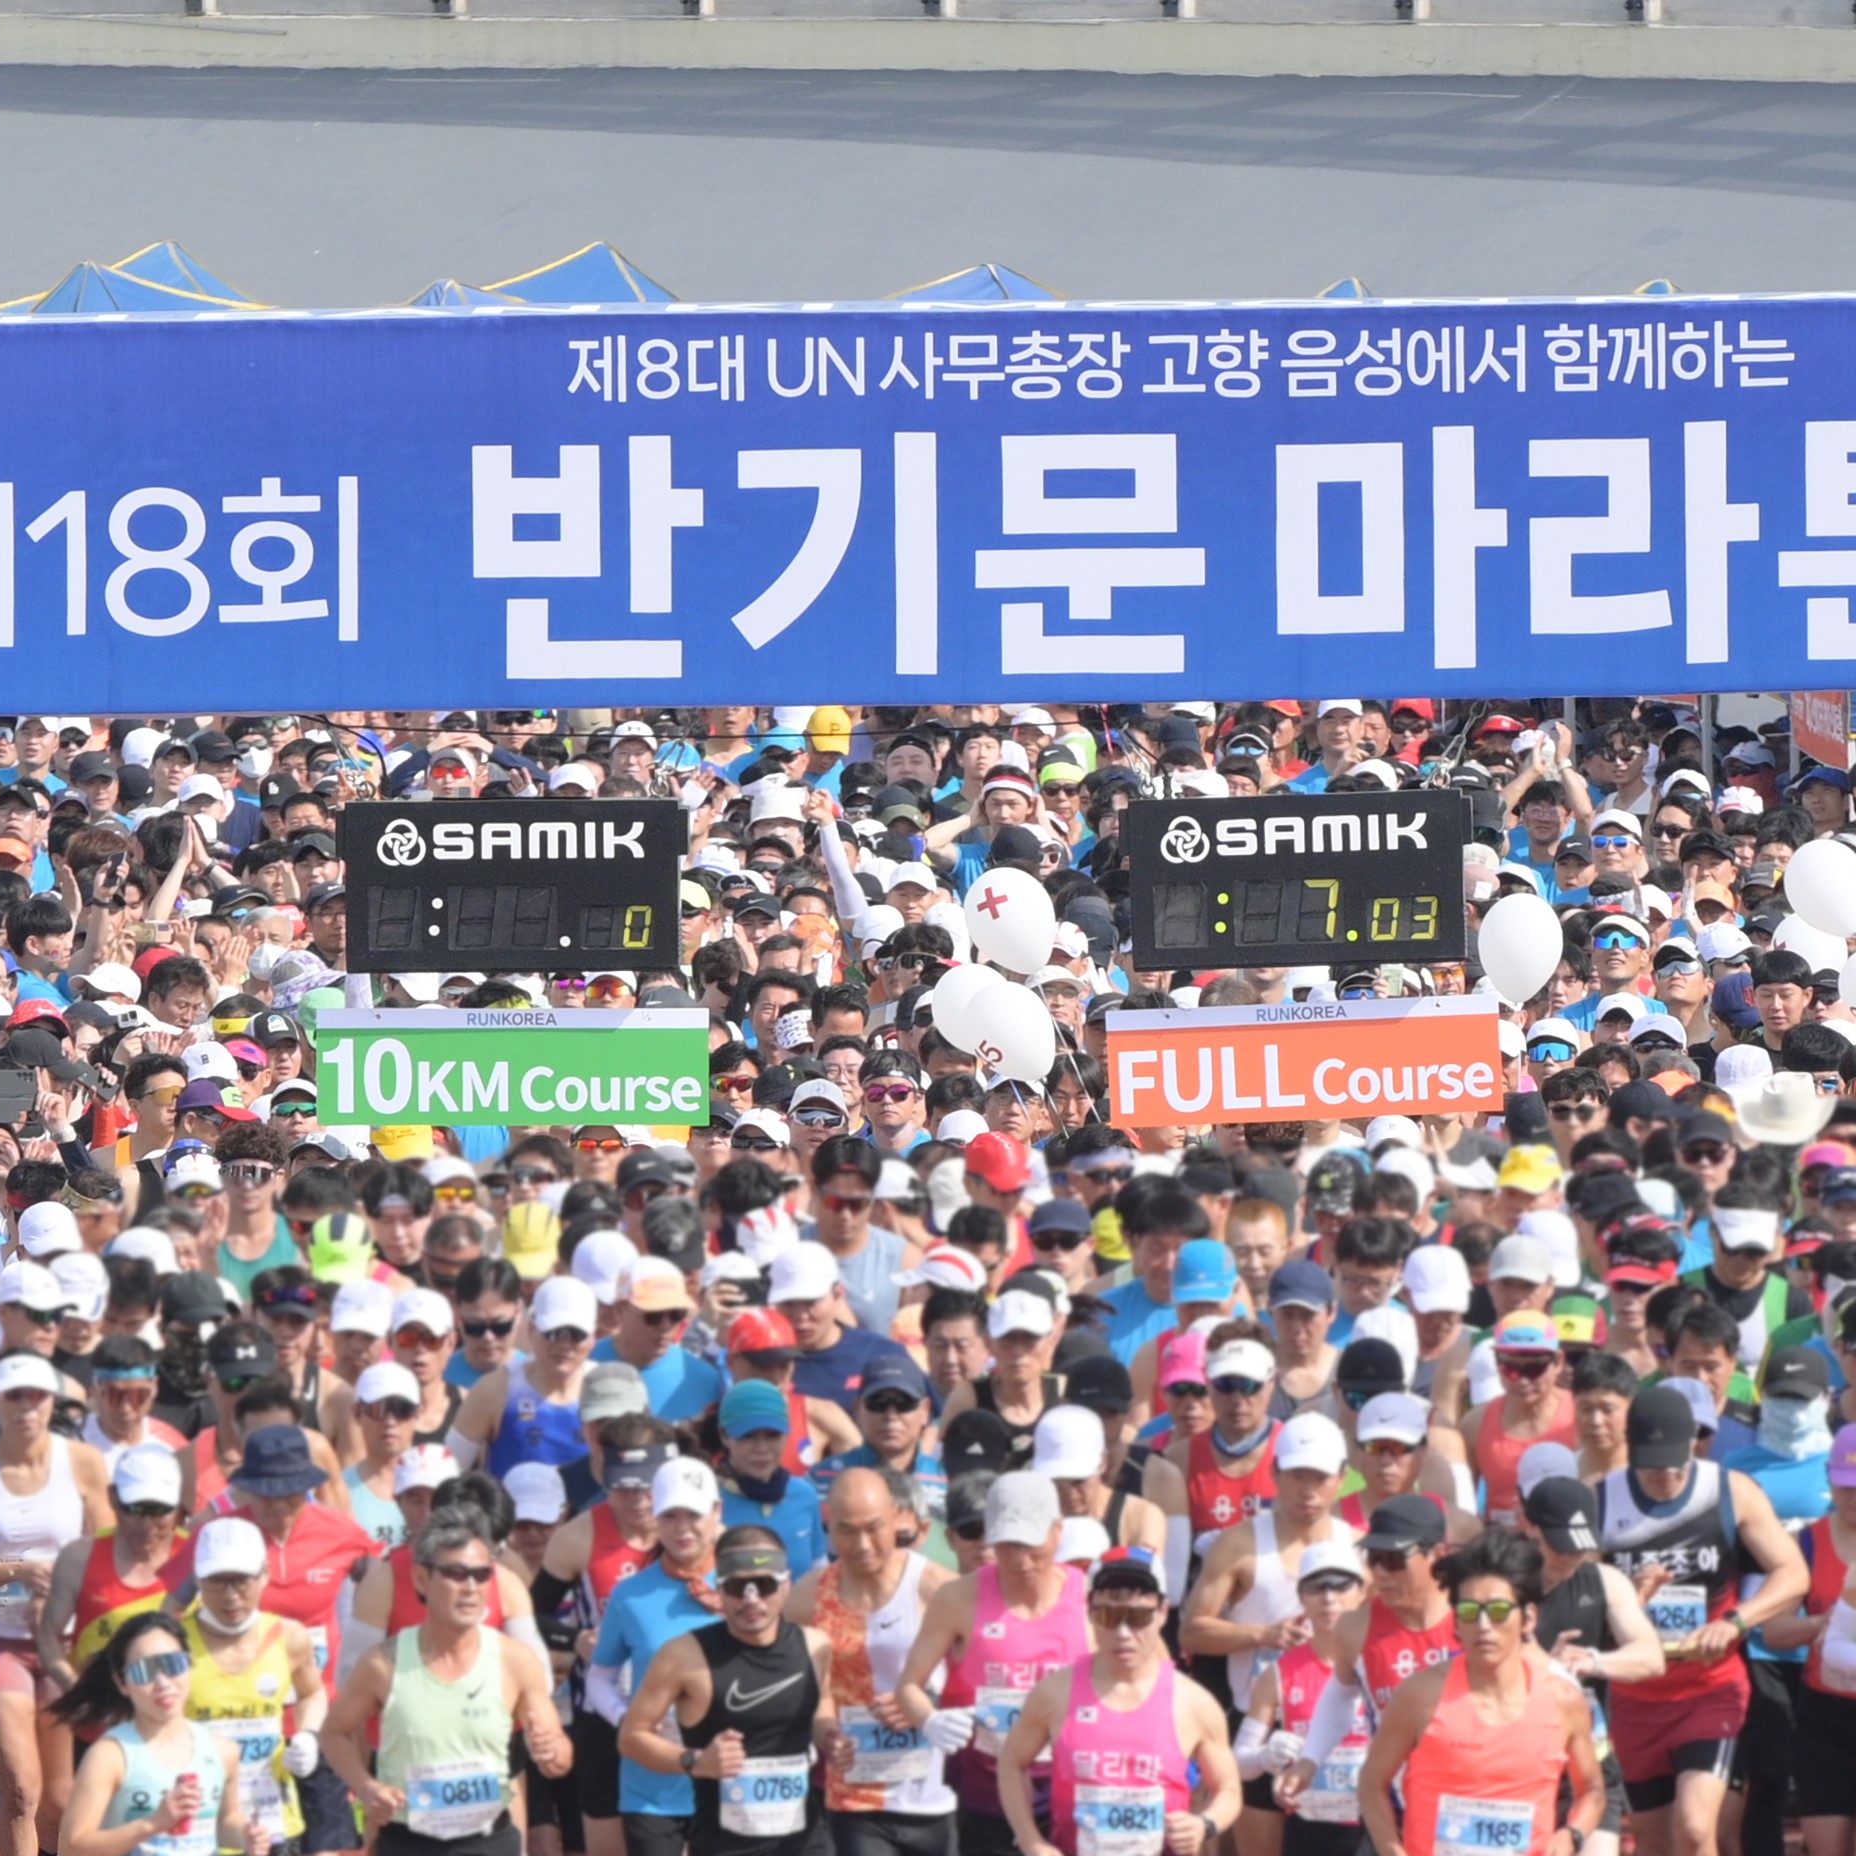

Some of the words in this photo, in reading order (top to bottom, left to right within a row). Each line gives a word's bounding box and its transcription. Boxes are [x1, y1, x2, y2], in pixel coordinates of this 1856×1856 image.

[566, 333, 746, 403] 제8대
[766, 335, 867, 399] UN
[878, 330, 1131, 401] 사무총장
[1142, 328, 1270, 398] 고향
[1280, 324, 1527, 397] 음성에서
[1542, 319, 1796, 392] 함께하는
[470, 430, 1207, 680] 반기문
[431, 820, 646, 861] SAMIK
[1215, 812, 1429, 857] SAMIK
[465, 1011, 558, 1028] RUNKOREA
[1255, 1003, 1348, 1023] RUNKOREA
[321, 1037, 510, 1116] 10KM
[519, 1065, 703, 1113] Course
[1116, 1042, 1307, 1116] FULL
[1311, 1058, 1496, 1106] Course
[442, 1776, 494, 1807] 0811
[753, 1777, 805, 1803] 0769
[1107, 1806, 1160, 1832] 0821
[1471, 1818, 1523, 1847] 1185
